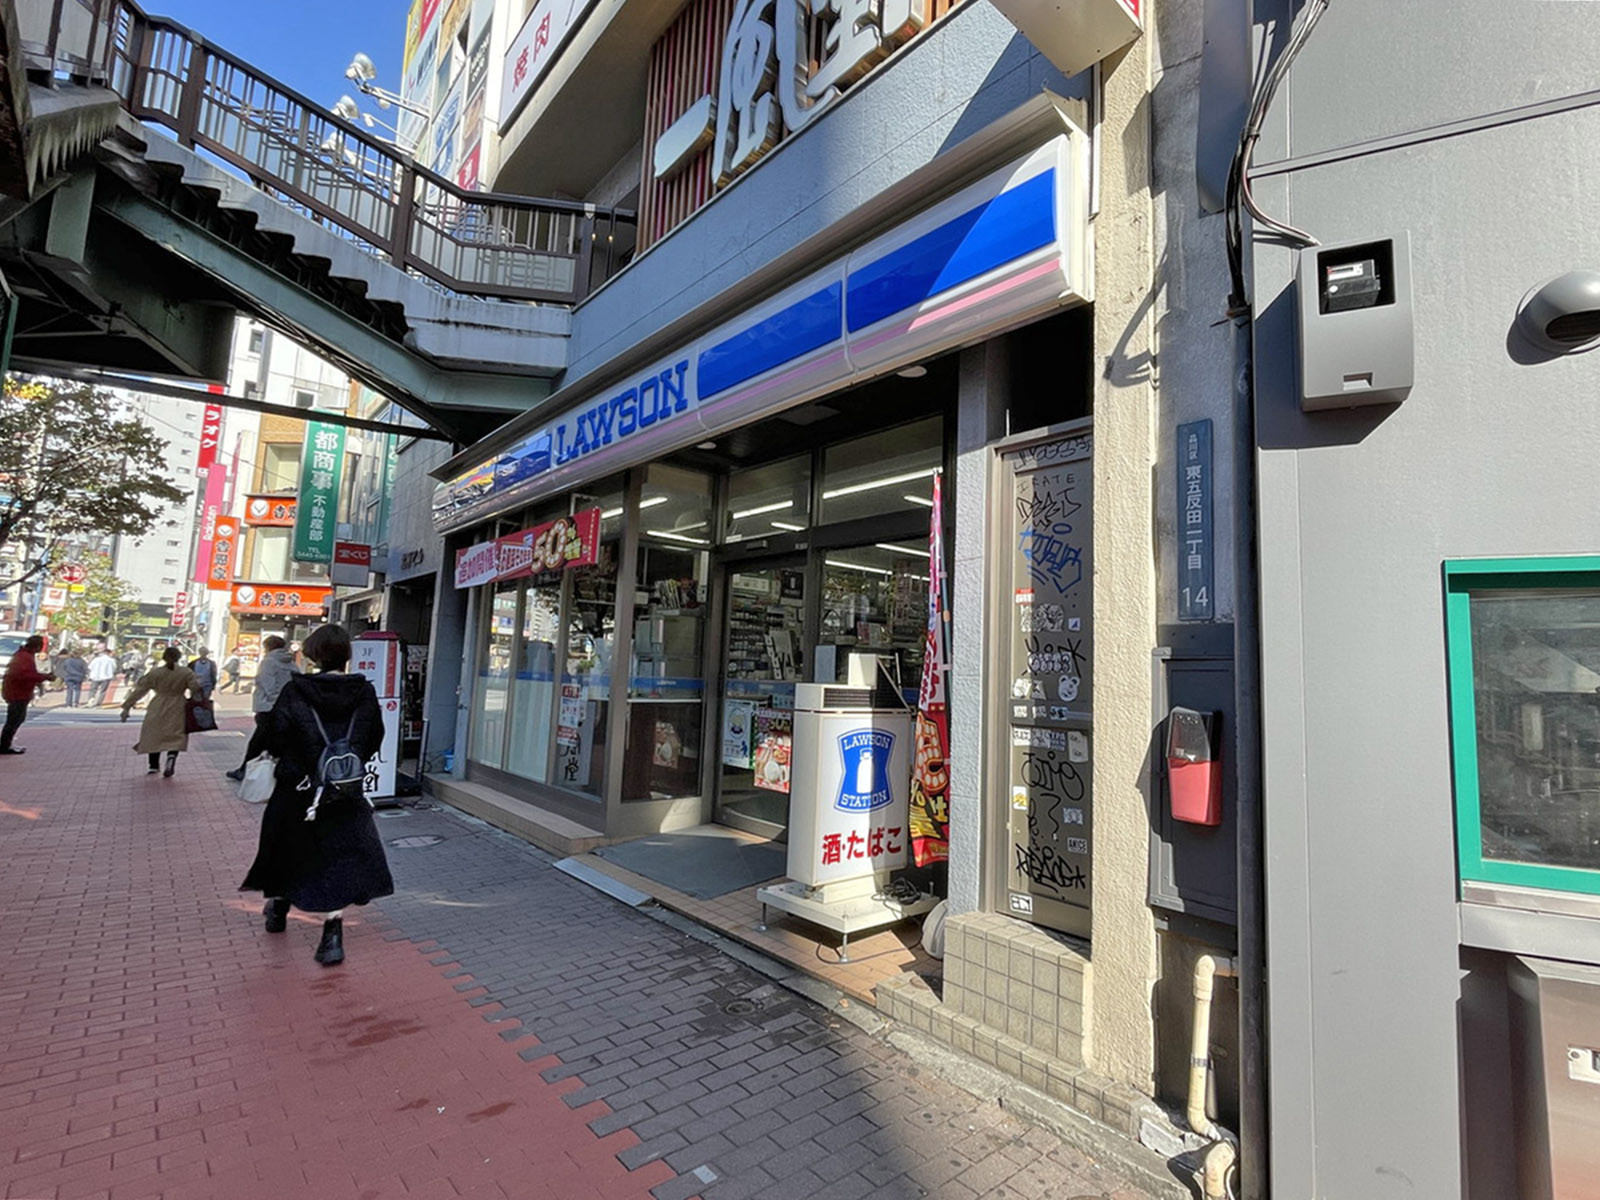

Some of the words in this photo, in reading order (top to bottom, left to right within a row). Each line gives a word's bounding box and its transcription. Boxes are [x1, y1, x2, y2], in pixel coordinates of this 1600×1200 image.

[203, 403, 222, 449] ラオケ
[556, 359, 689, 465] LAWSON
[310, 430, 338, 489] 都商事
[309, 494, 327, 541] 不動産部
[1185, 464, 1203, 570] 東五反田一丁目
[259, 591, 301, 607] 吉野家
[1182, 586, 1209, 607] 14
[361, 648, 373, 656] 3F
[843, 734, 891, 750] LAWSON
[840, 790, 888, 807] STATION
[822, 827, 902, 865] 酒・たばこ
